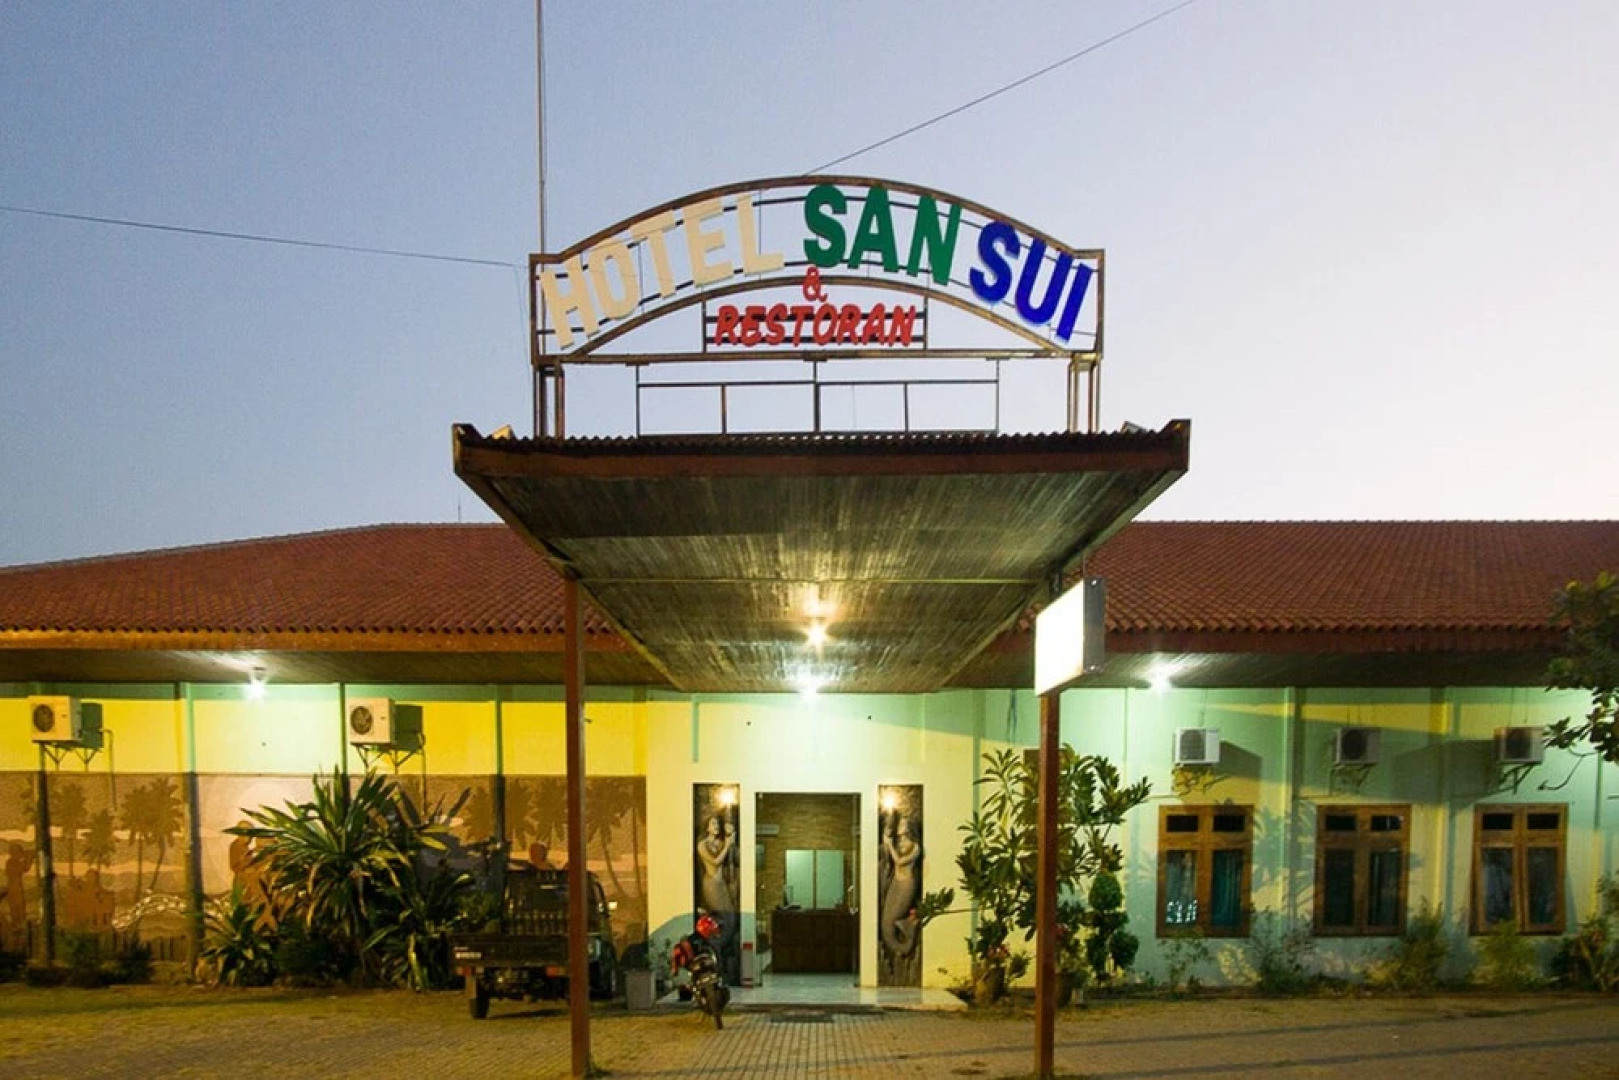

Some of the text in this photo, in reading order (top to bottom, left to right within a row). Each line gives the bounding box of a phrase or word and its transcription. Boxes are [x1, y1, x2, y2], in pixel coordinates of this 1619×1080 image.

[540, 183, 1093, 348] HOTEL SAN SUI
[803, 266, 828, 302] &
[714, 303, 916, 346] RESTORAN
